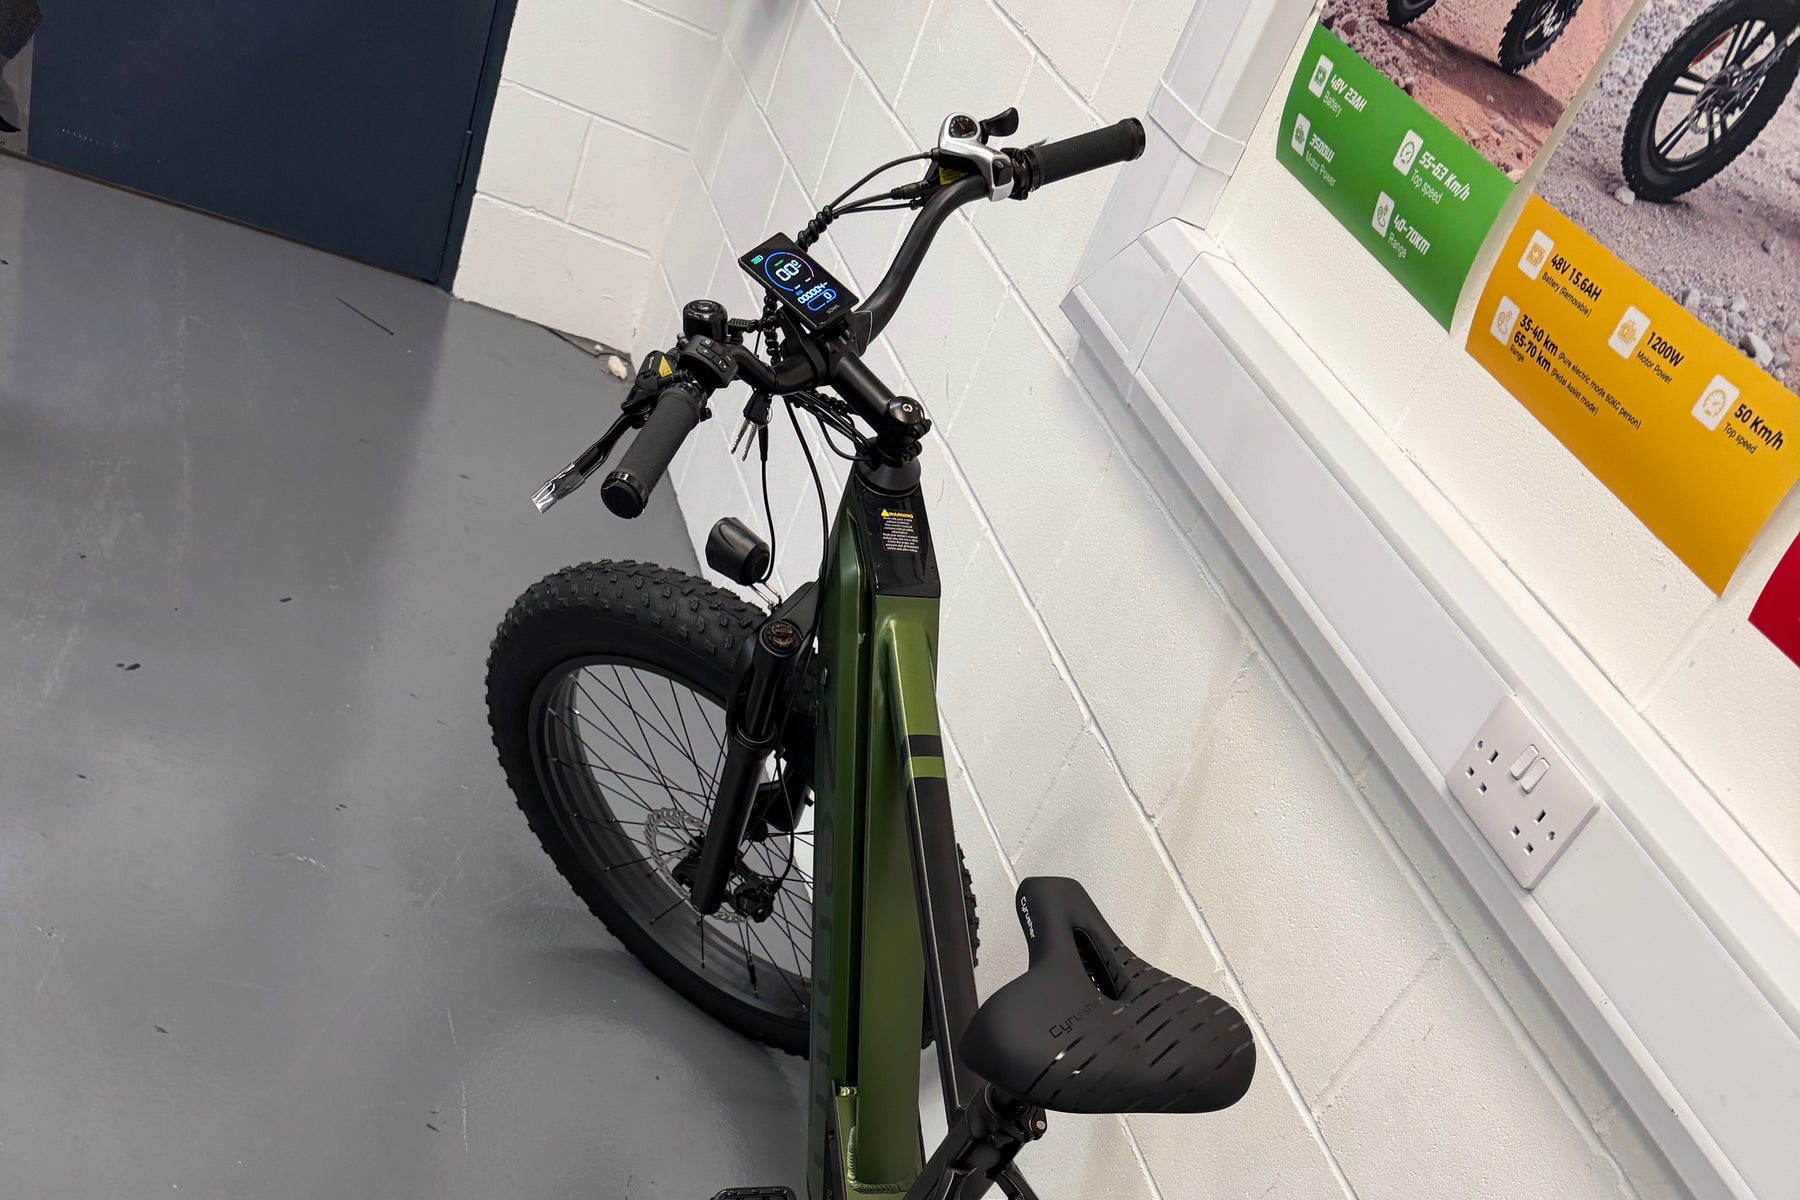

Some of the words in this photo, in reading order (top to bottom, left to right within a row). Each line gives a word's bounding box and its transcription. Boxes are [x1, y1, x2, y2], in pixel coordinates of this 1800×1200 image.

[1330, 74, 1347, 94] 48V
[1322, 91, 1342, 117] Battery
[1309, 133, 1335, 164] 3500W
[1305, 150, 1320, 171] Motor
[1319, 165, 1337, 187] Power
[1419, 151, 1448, 180] 55-63
[1444, 175, 1470, 201] Km/h
[1410, 170, 1422, 190] Top
[1421, 182, 1444, 205] speed
[1388, 232, 1407, 258] Range
[1541, 272, 1561, 293] Battery
[1559, 287, 1592, 318] (Removable)
[1551, 254, 1571, 275] 48V
[1568, 268, 1602, 302] 15.6AH
[1509, 345, 1524, 363] Range
[1647, 331, 1685, 367] 1200W
[1514, 331, 1537, 358] 65-70
[1536, 351, 1551, 372] km
[1551, 368, 1567, 389] (Pedal
[1566, 381, 1581, 400] Assist
[1580, 397, 1599, 416] mode)
[1520, 314, 1544, 341] 35-40
[1543, 332, 1558, 356] km
[1558, 351, 1571, 369] (Pure
[1571, 364, 1591, 384] electric
[1590, 381, 1606, 398] mode
[1618, 405, 1642, 430] person)
[1636, 351, 1654, 369] Motor
[1653, 365, 1672, 385] Power
[1723, 422, 1736, 439] Top
[1735, 432, 1757, 454] speed
[1734, 403, 1752, 423] 50
[1750, 415, 1783, 451] Km/h
